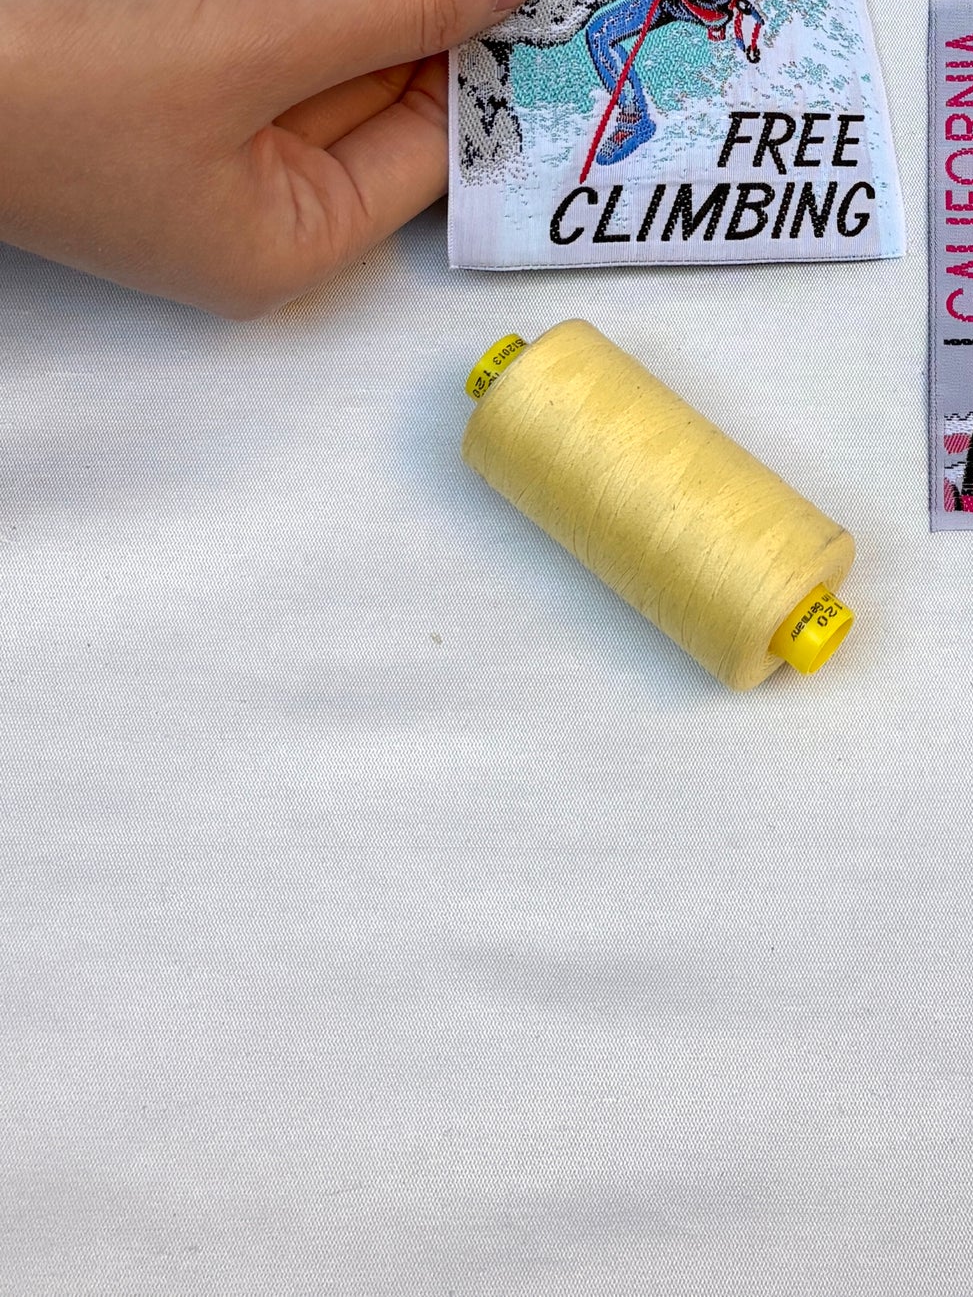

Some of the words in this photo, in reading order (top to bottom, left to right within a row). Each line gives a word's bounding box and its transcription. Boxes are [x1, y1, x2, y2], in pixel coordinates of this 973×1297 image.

[718, 111, 865, 175] FREE
[550, 181, 876, 245] CLIMBING
[472, 370, 491, 398] 120
[790, 601, 825, 642] Germany
[816, 602, 843, 627] 120
